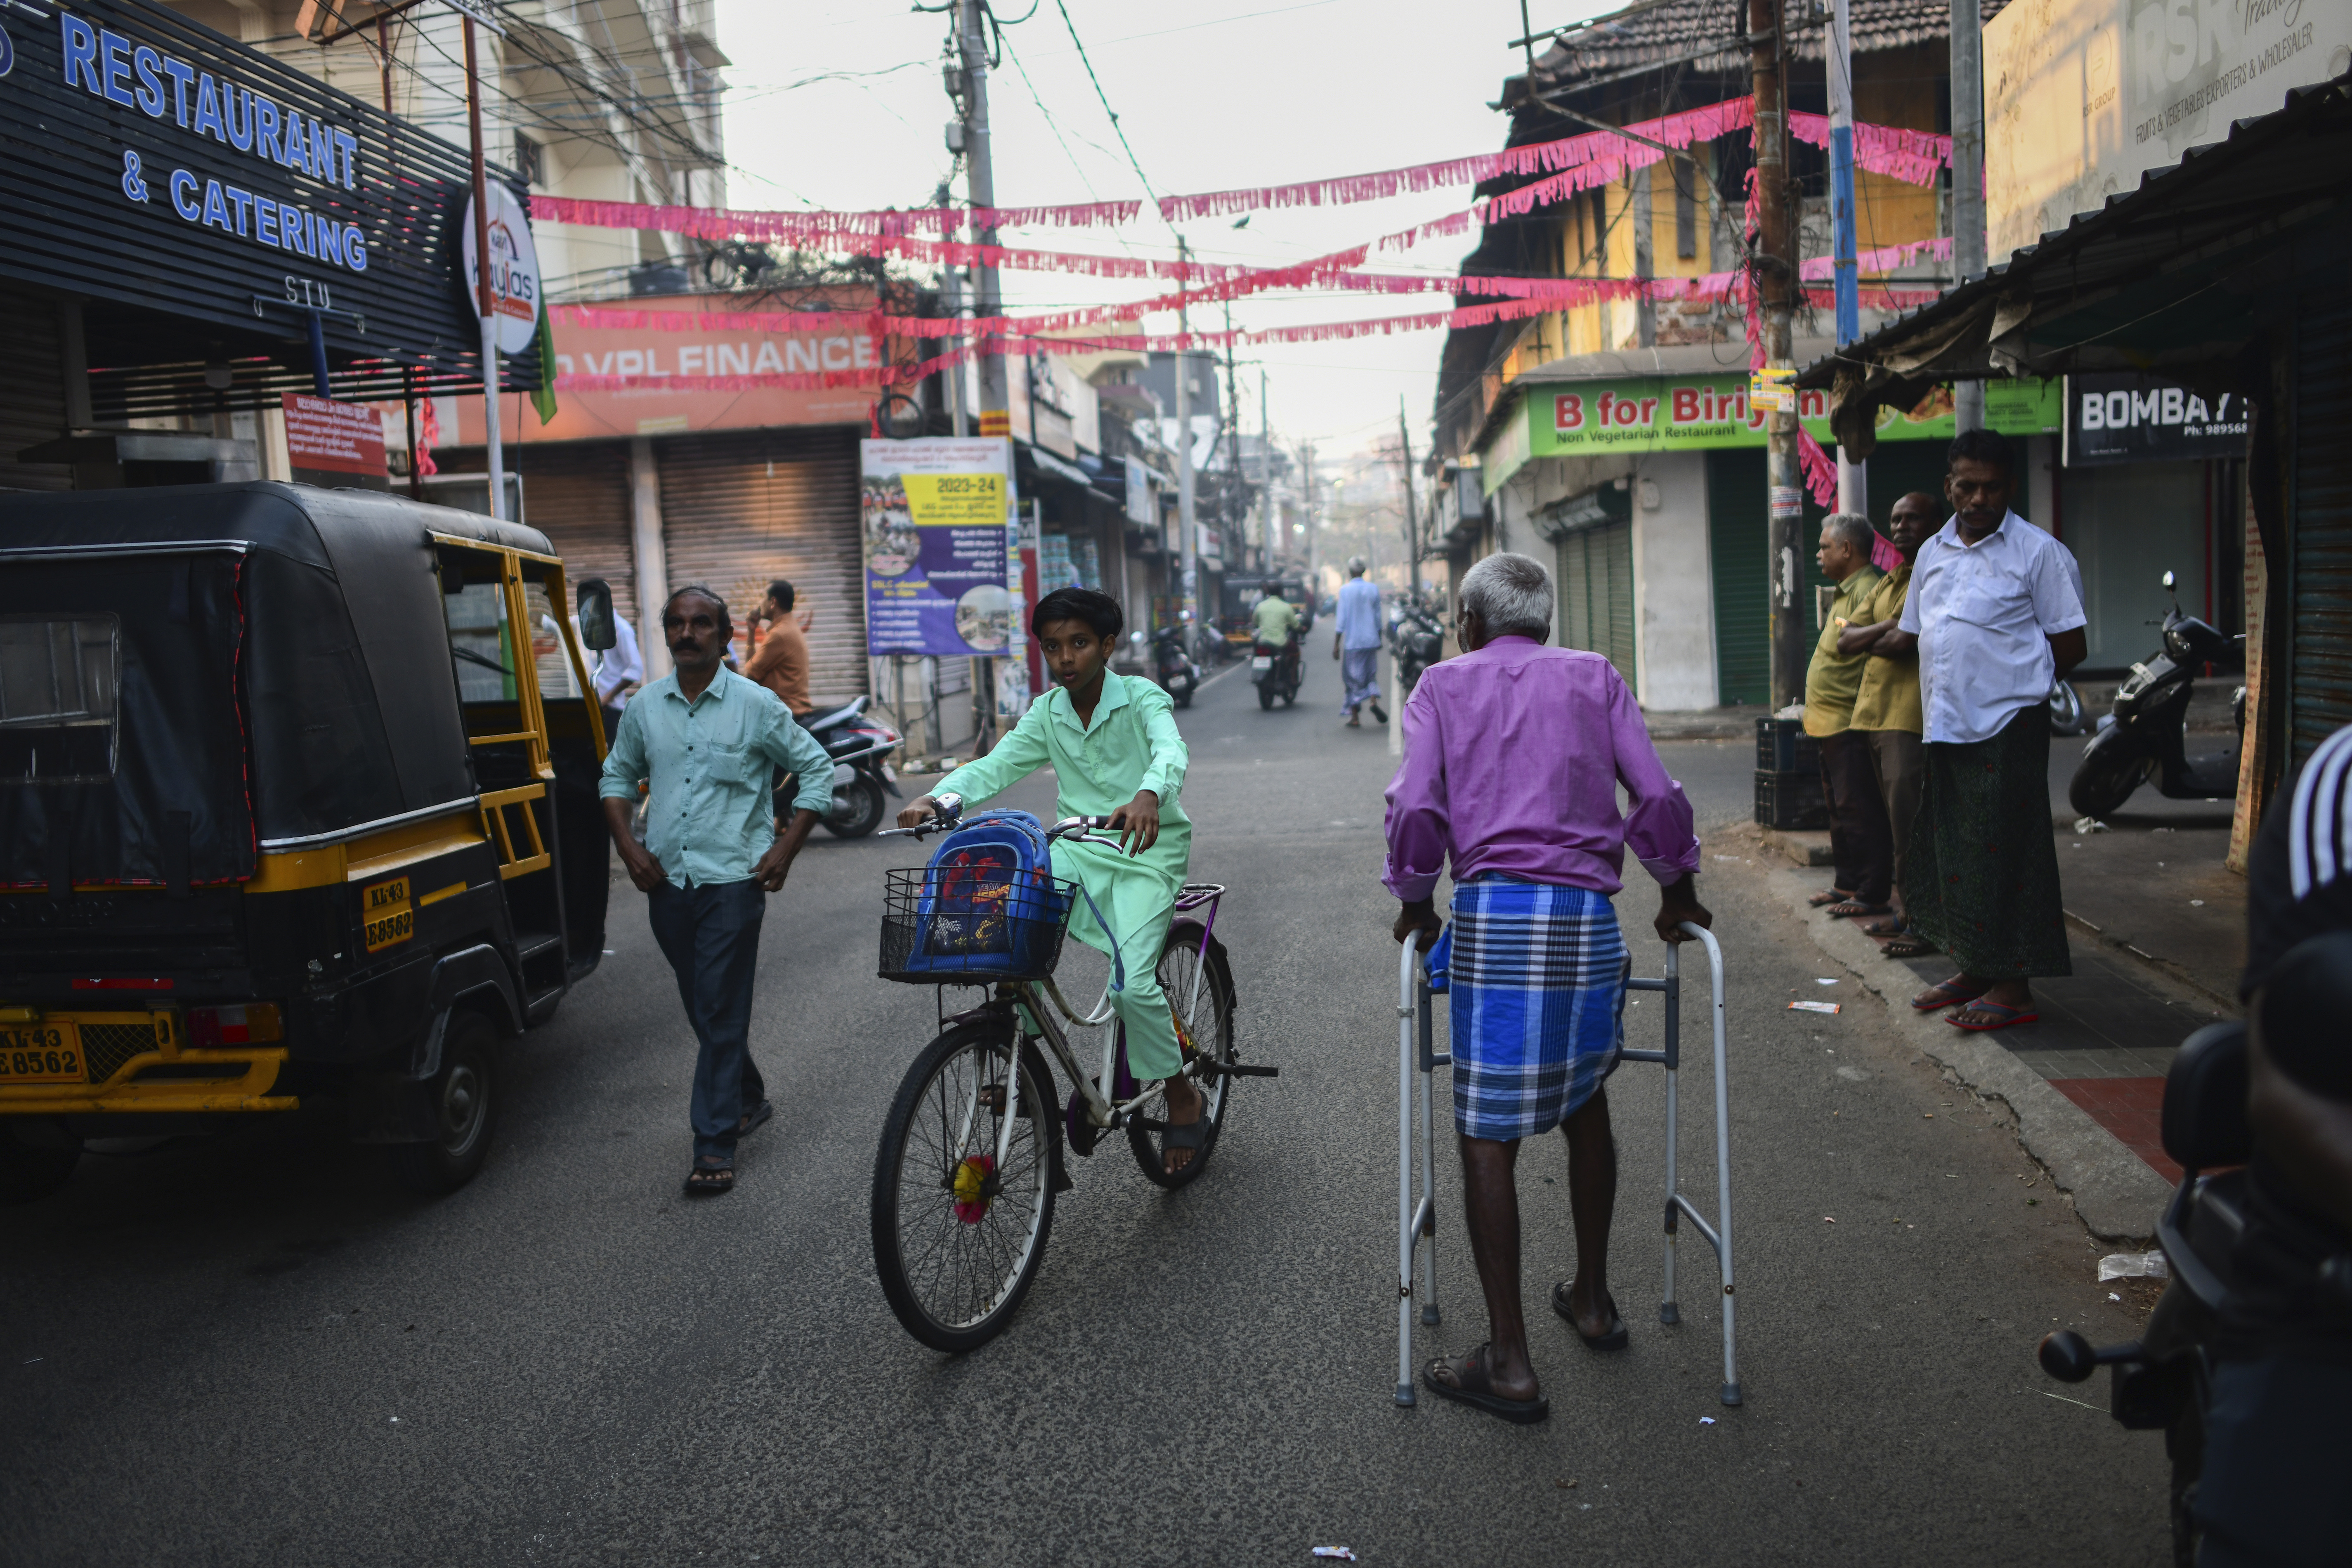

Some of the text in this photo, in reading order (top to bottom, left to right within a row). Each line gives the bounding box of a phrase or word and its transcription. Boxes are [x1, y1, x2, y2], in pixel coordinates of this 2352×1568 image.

[2136, 22, 2313, 145] FRUITS & VEGETABLES EXPORTERS & WHOLESALER
[61, 11, 357, 190] RESTAURANT
[2083, 87, 2116, 118] RSR GROUP
[121, 149, 367, 272] & CATERING
[583, 348, 670, 378] VPL
[678, 335, 882, 377] FINANCE
[1555, 393, 1585, 431] B
[1597, 390, 1659, 428] for
[2082, 387, 2230, 430] BOMBAY
[1556, 424, 1736, 444] Non Vegetarian Restaurant
[2184, 425, 2202, 437] Ph:
[937, 477, 995, 494] 2023-24
[371, 882, 403, 907] KL-43
[972, 884, 1010, 902] HEROES
[977, 883, 1000, 892] TEAM
[367, 912, 411, 946] E8562
[0, 1029, 61, 1048] KL-43
[0, 1051, 78, 1074] E8562
